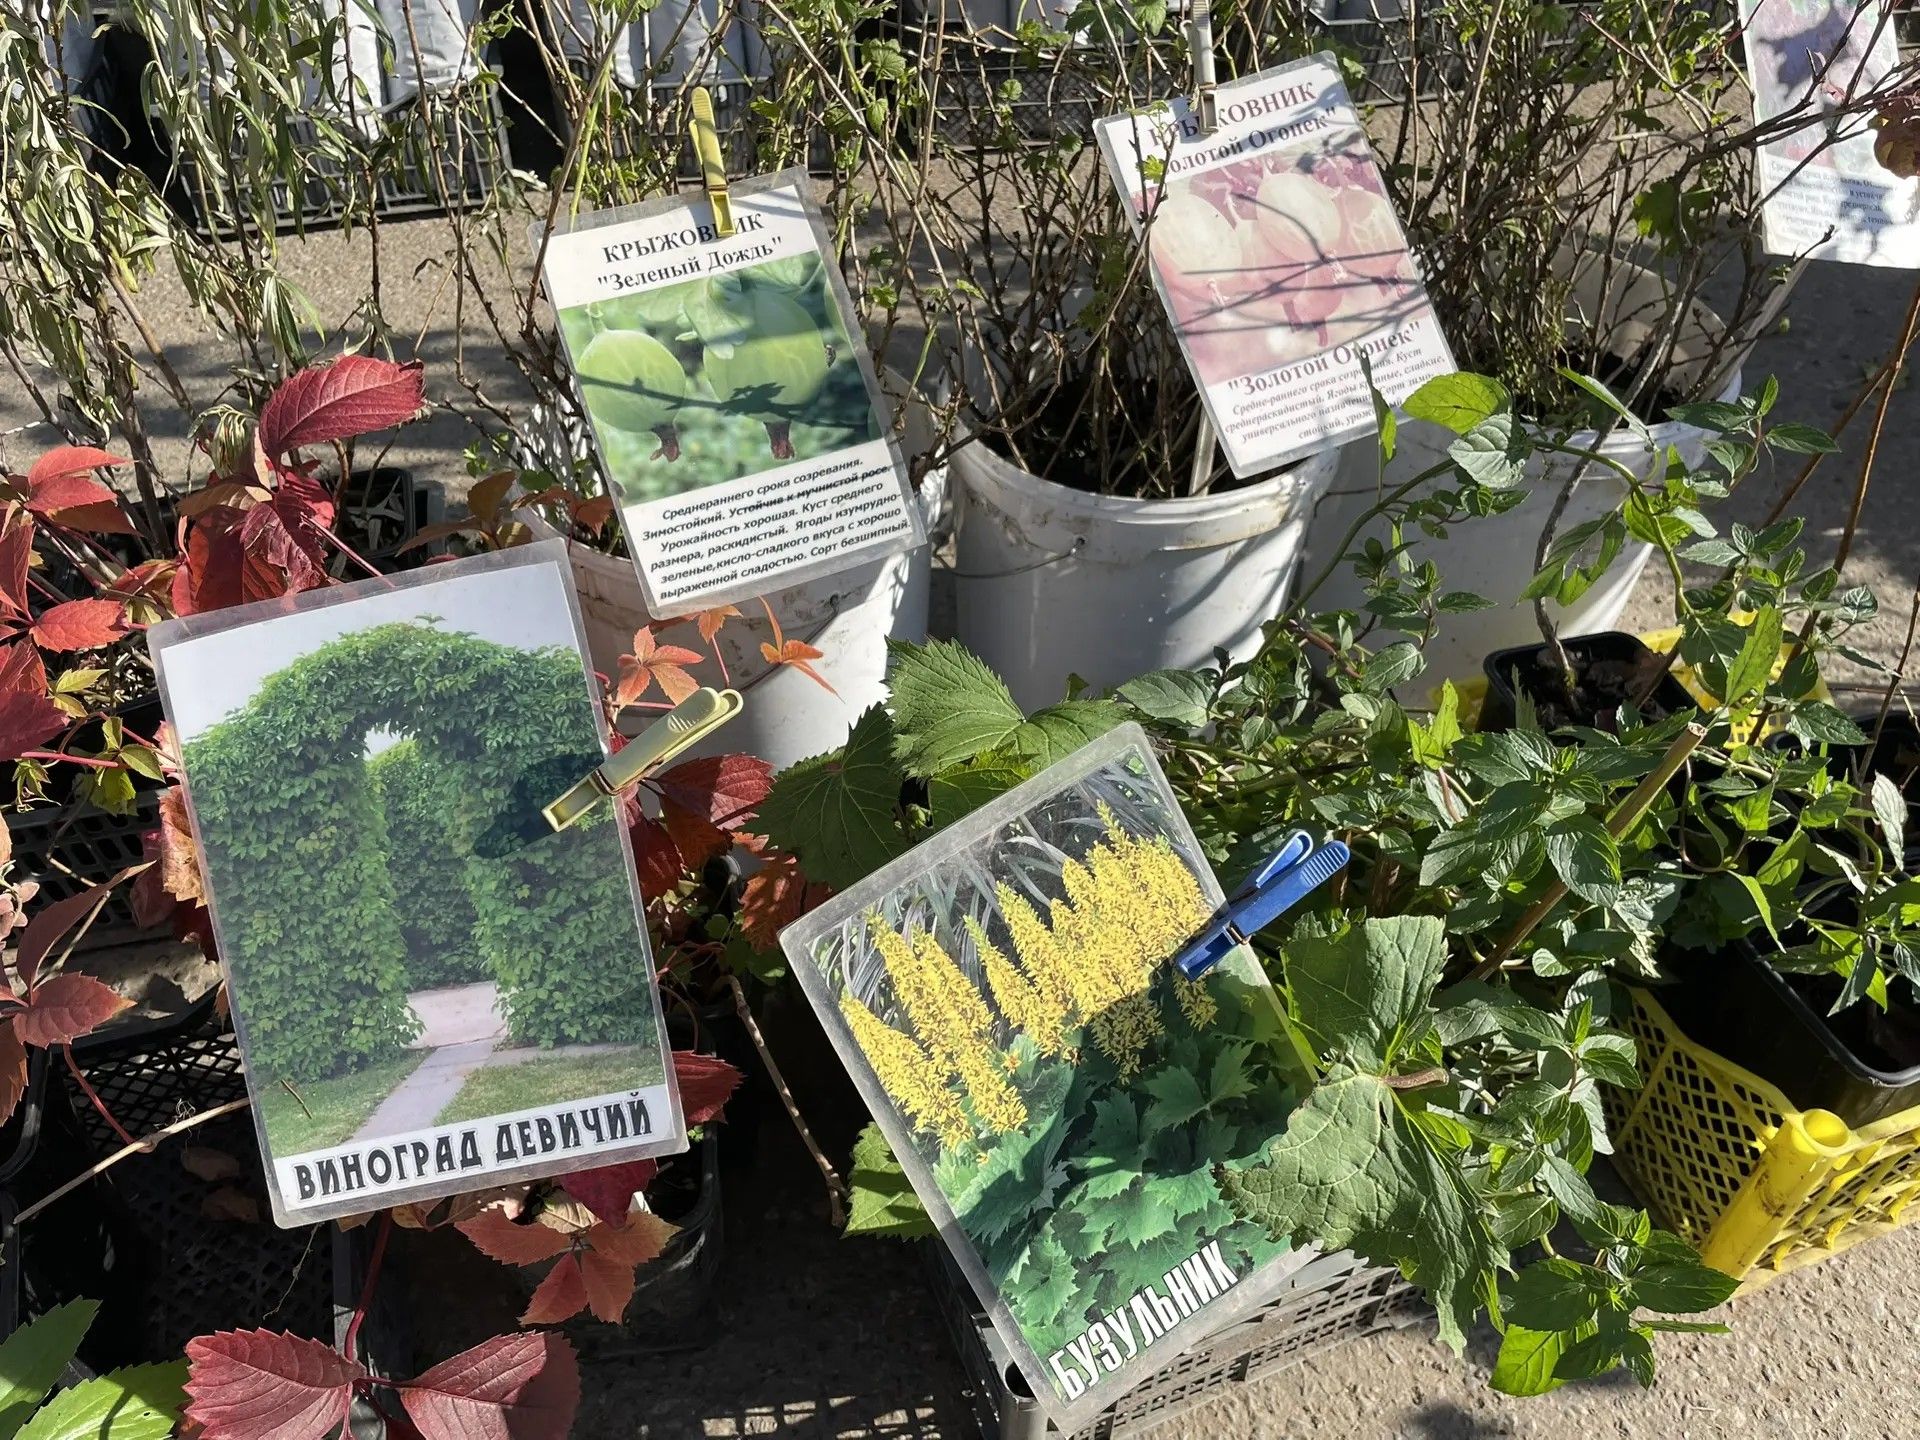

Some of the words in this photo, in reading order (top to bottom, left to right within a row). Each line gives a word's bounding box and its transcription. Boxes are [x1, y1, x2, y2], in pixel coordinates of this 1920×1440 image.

[1165, 135, 1244, 175] олотой
[1248, 106, 1337, 149] Огонек"
[597, 257, 701, 292] "Зеленый
[707, 235, 783, 273] Дождь"
[1228, 353, 1330, 396] "Золотой
[1232, 384, 1308, 417] Средне-раннего
[1309, 375, 1337, 393] срока
[1396, 348, 1422, 362] Куст
[1326, 383, 1357, 400] Ягоды
[1242, 411, 1317, 444] универсального
[1298, 416, 1344, 440] стойкий,
[642, 510, 726, 541] Зимостойкий.
[729, 496, 785, 518] Устойчив
[797, 472, 859, 499] мучнистой
[660, 524, 740, 552] Урожайность
[743, 508, 798, 530] хорошая.
[802, 499, 828, 514] Куст
[830, 482, 884, 505] среднего
[662, 488, 755, 521] Среднераннего
[756, 478, 791, 496] срока
[793, 458, 864, 486] созревания.
[812, 525, 845, 541] вкуса
[847, 521, 855, 531] с
[857, 507, 902, 528] хорошо
[650, 550, 704, 573] размера,
[707, 524, 788, 557] раскидистый.
[795, 513, 832, 532] Ягоды
[835, 493, 902, 519] изумрудно-
[660, 569, 738, 600] выраженной
[740, 552, 807, 578] сладостью.
[810, 542, 838, 557] Сорт
[841, 517, 912, 549] безшипный.
[294, 1130, 484, 1201] ВИНОГРАД
[495, 1090, 653, 1165] ДЕВИЧИЙ
[1047, 1239, 1239, 1402] БУЗУЛЬНИК
